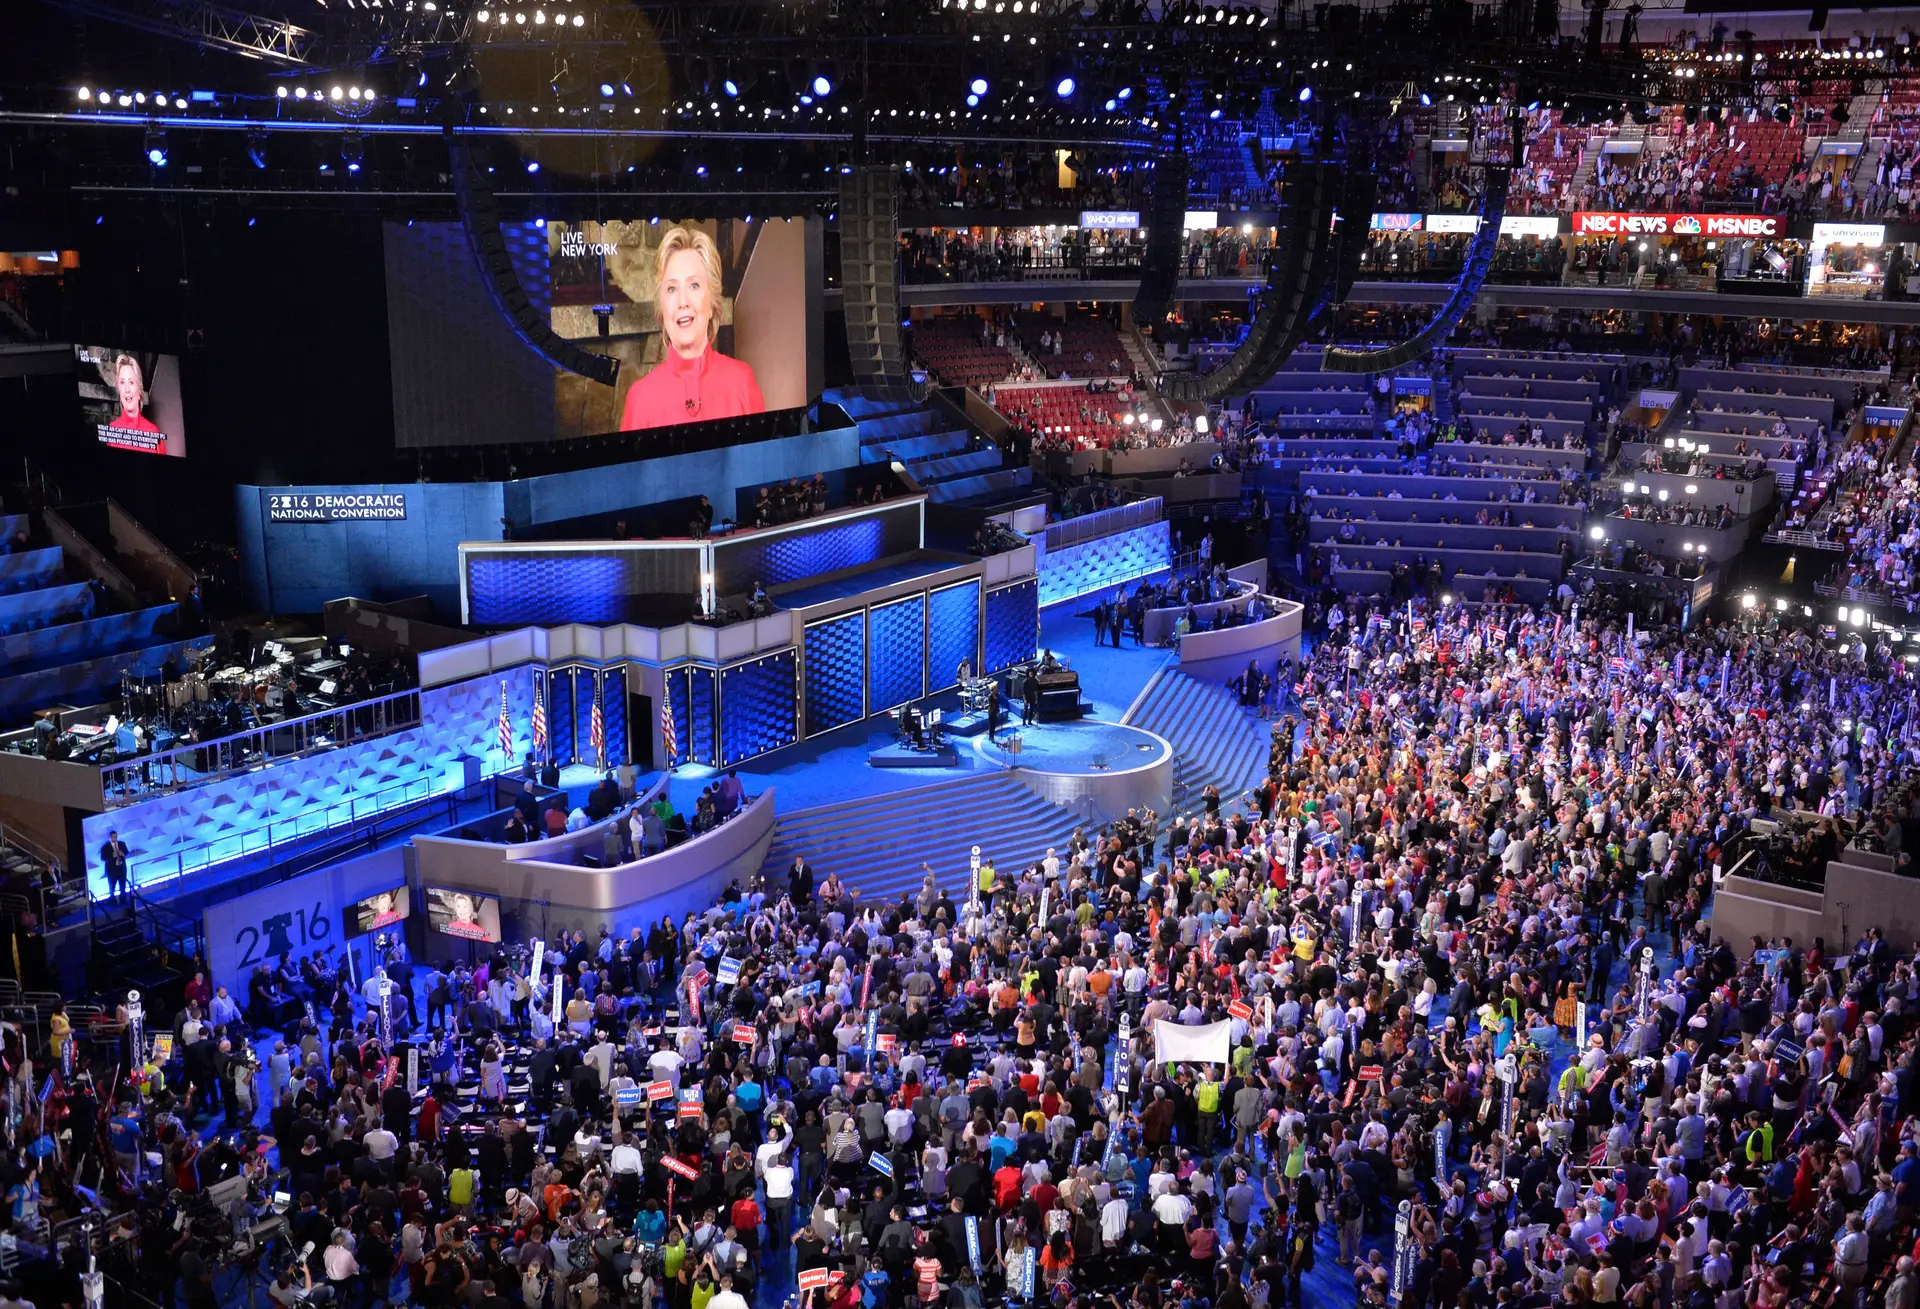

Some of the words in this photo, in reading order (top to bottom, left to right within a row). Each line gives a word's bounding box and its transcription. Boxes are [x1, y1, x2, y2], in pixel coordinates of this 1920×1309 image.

[1086, 214, 1116, 224] YAHOO!
[1117, 215, 1136, 223] NEWS
[1383, 213, 1410, 228] CNN
[1581, 215, 1616, 232] NBC
[1619, 215, 1667, 233] NEWS
[1707, 217, 1776, 235] MSNBC
[561, 232, 583, 244] LIVE
[561, 244, 586, 257] NEW
[589, 243, 618, 256] YORK
[1892, 419, 1903, 427] 118
[315, 494, 404, 507] DEMOCRATIC
[271, 508, 326, 519] NATIONAL
[331, 507, 404, 518] CONVENTION
[720, 960, 740, 971] History
[1231, 1004, 1250, 1016] History
[735, 1030, 754, 1039] History
[867, 1011, 876, 1050] AMERICA
[1779, 1042, 1800, 1058] History
[1119, 1040, 1128, 1085] IOWA
[648, 1086, 670, 1095] History
[663, 1157, 696, 1178] AMERIC
[871, 1156, 893, 1171] History
[967, 1218, 978, 1270] AMERICA
[1395, 1232, 1404, 1253] NEW
[1024, 1249, 1034, 1293] AMERICA
[800, 1273, 826, 1285] History
